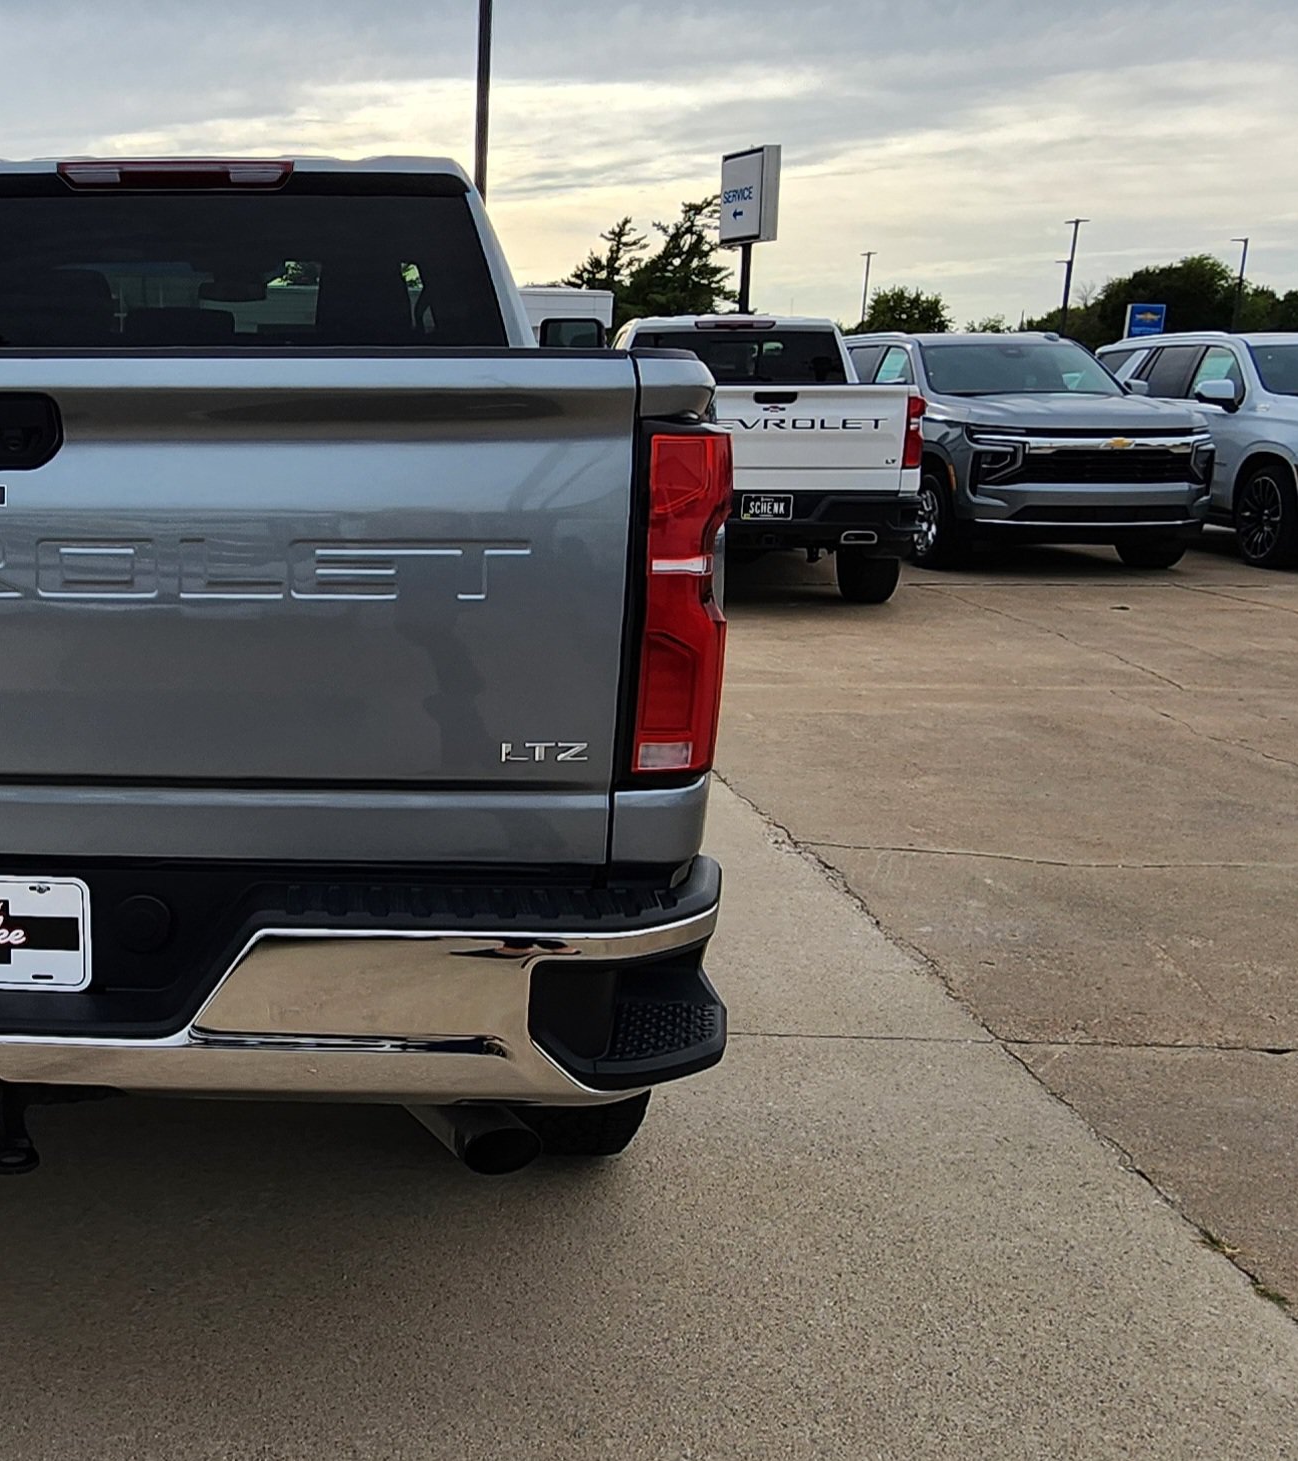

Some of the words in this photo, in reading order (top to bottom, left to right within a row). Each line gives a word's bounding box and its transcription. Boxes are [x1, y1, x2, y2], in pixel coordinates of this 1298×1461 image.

[723, 186, 753, 204] SERVICE
[749, 501, 785, 514] SCHENK
[501, 742, 589, 762] LTZ
